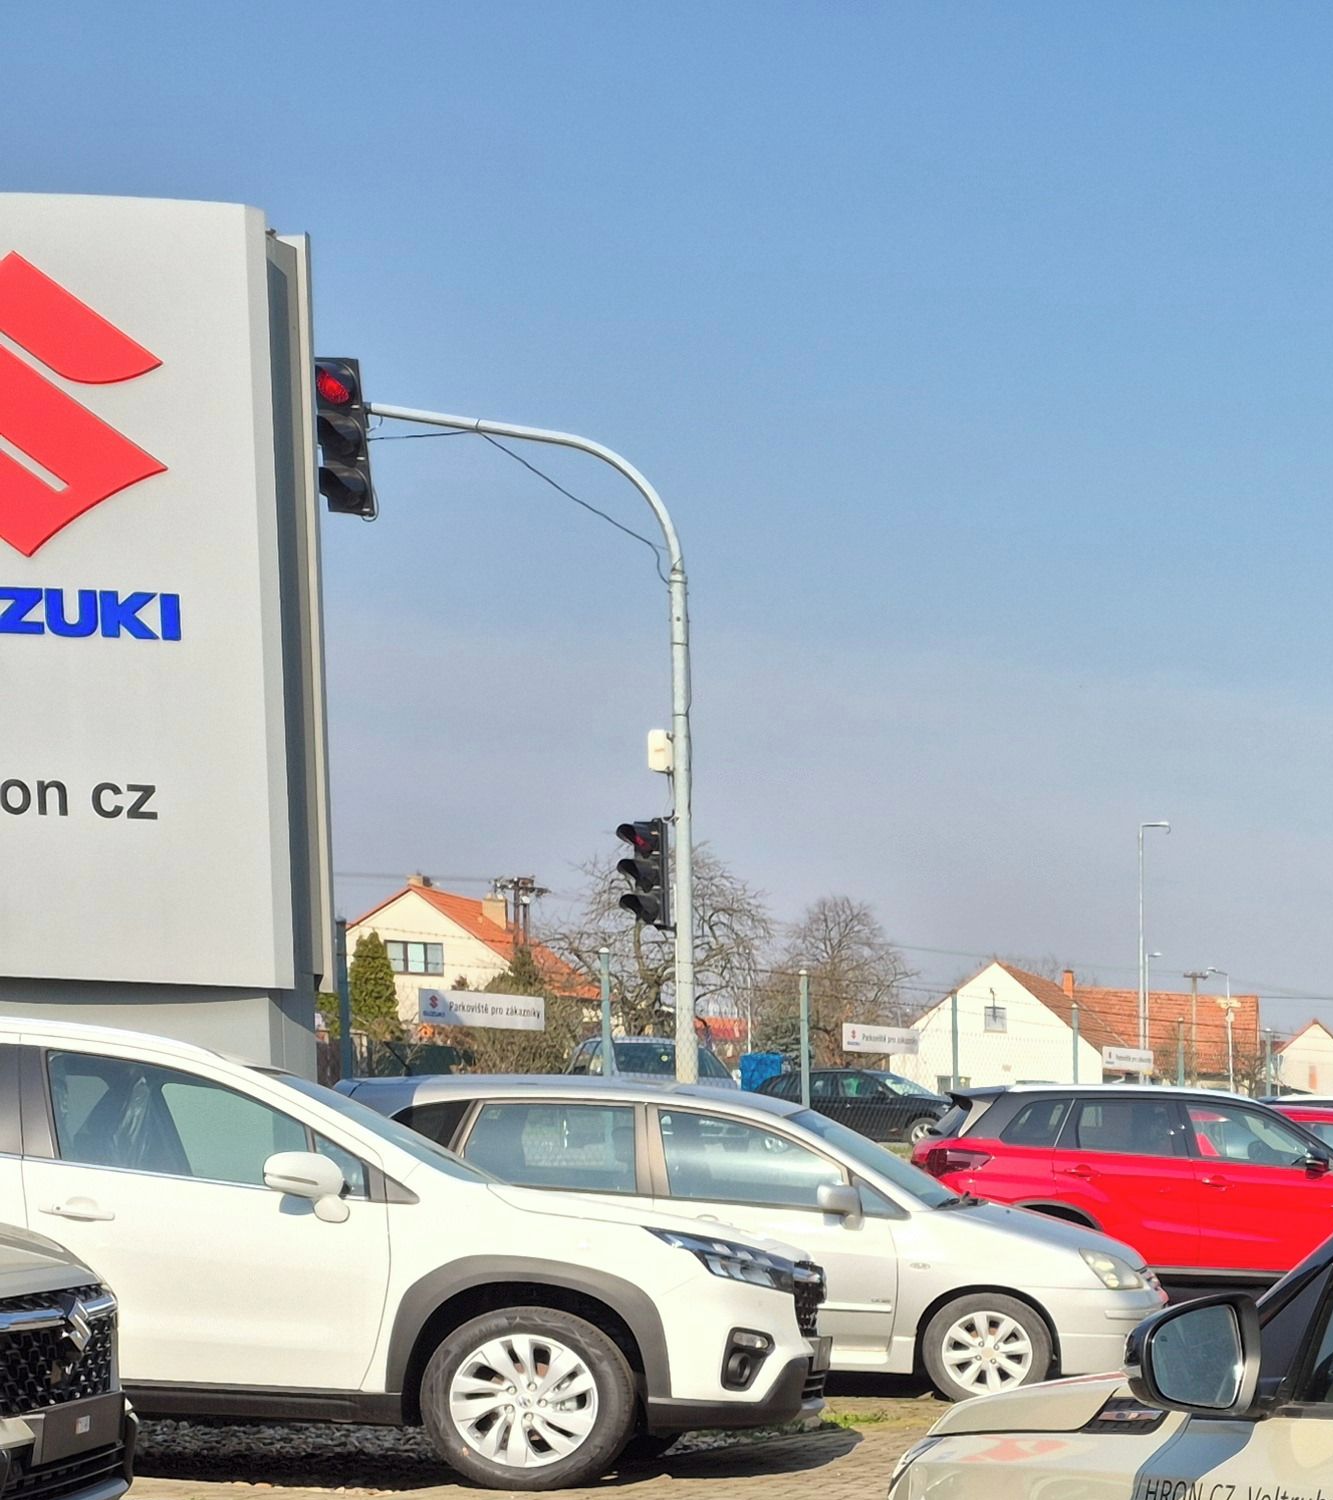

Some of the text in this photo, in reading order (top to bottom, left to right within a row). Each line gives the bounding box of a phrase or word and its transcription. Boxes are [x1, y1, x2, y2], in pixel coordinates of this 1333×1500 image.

[92, 782, 158, 820] cz
[449, 1001, 488, 1014] Parkoviště
[491, 1006, 503, 1016] pro
